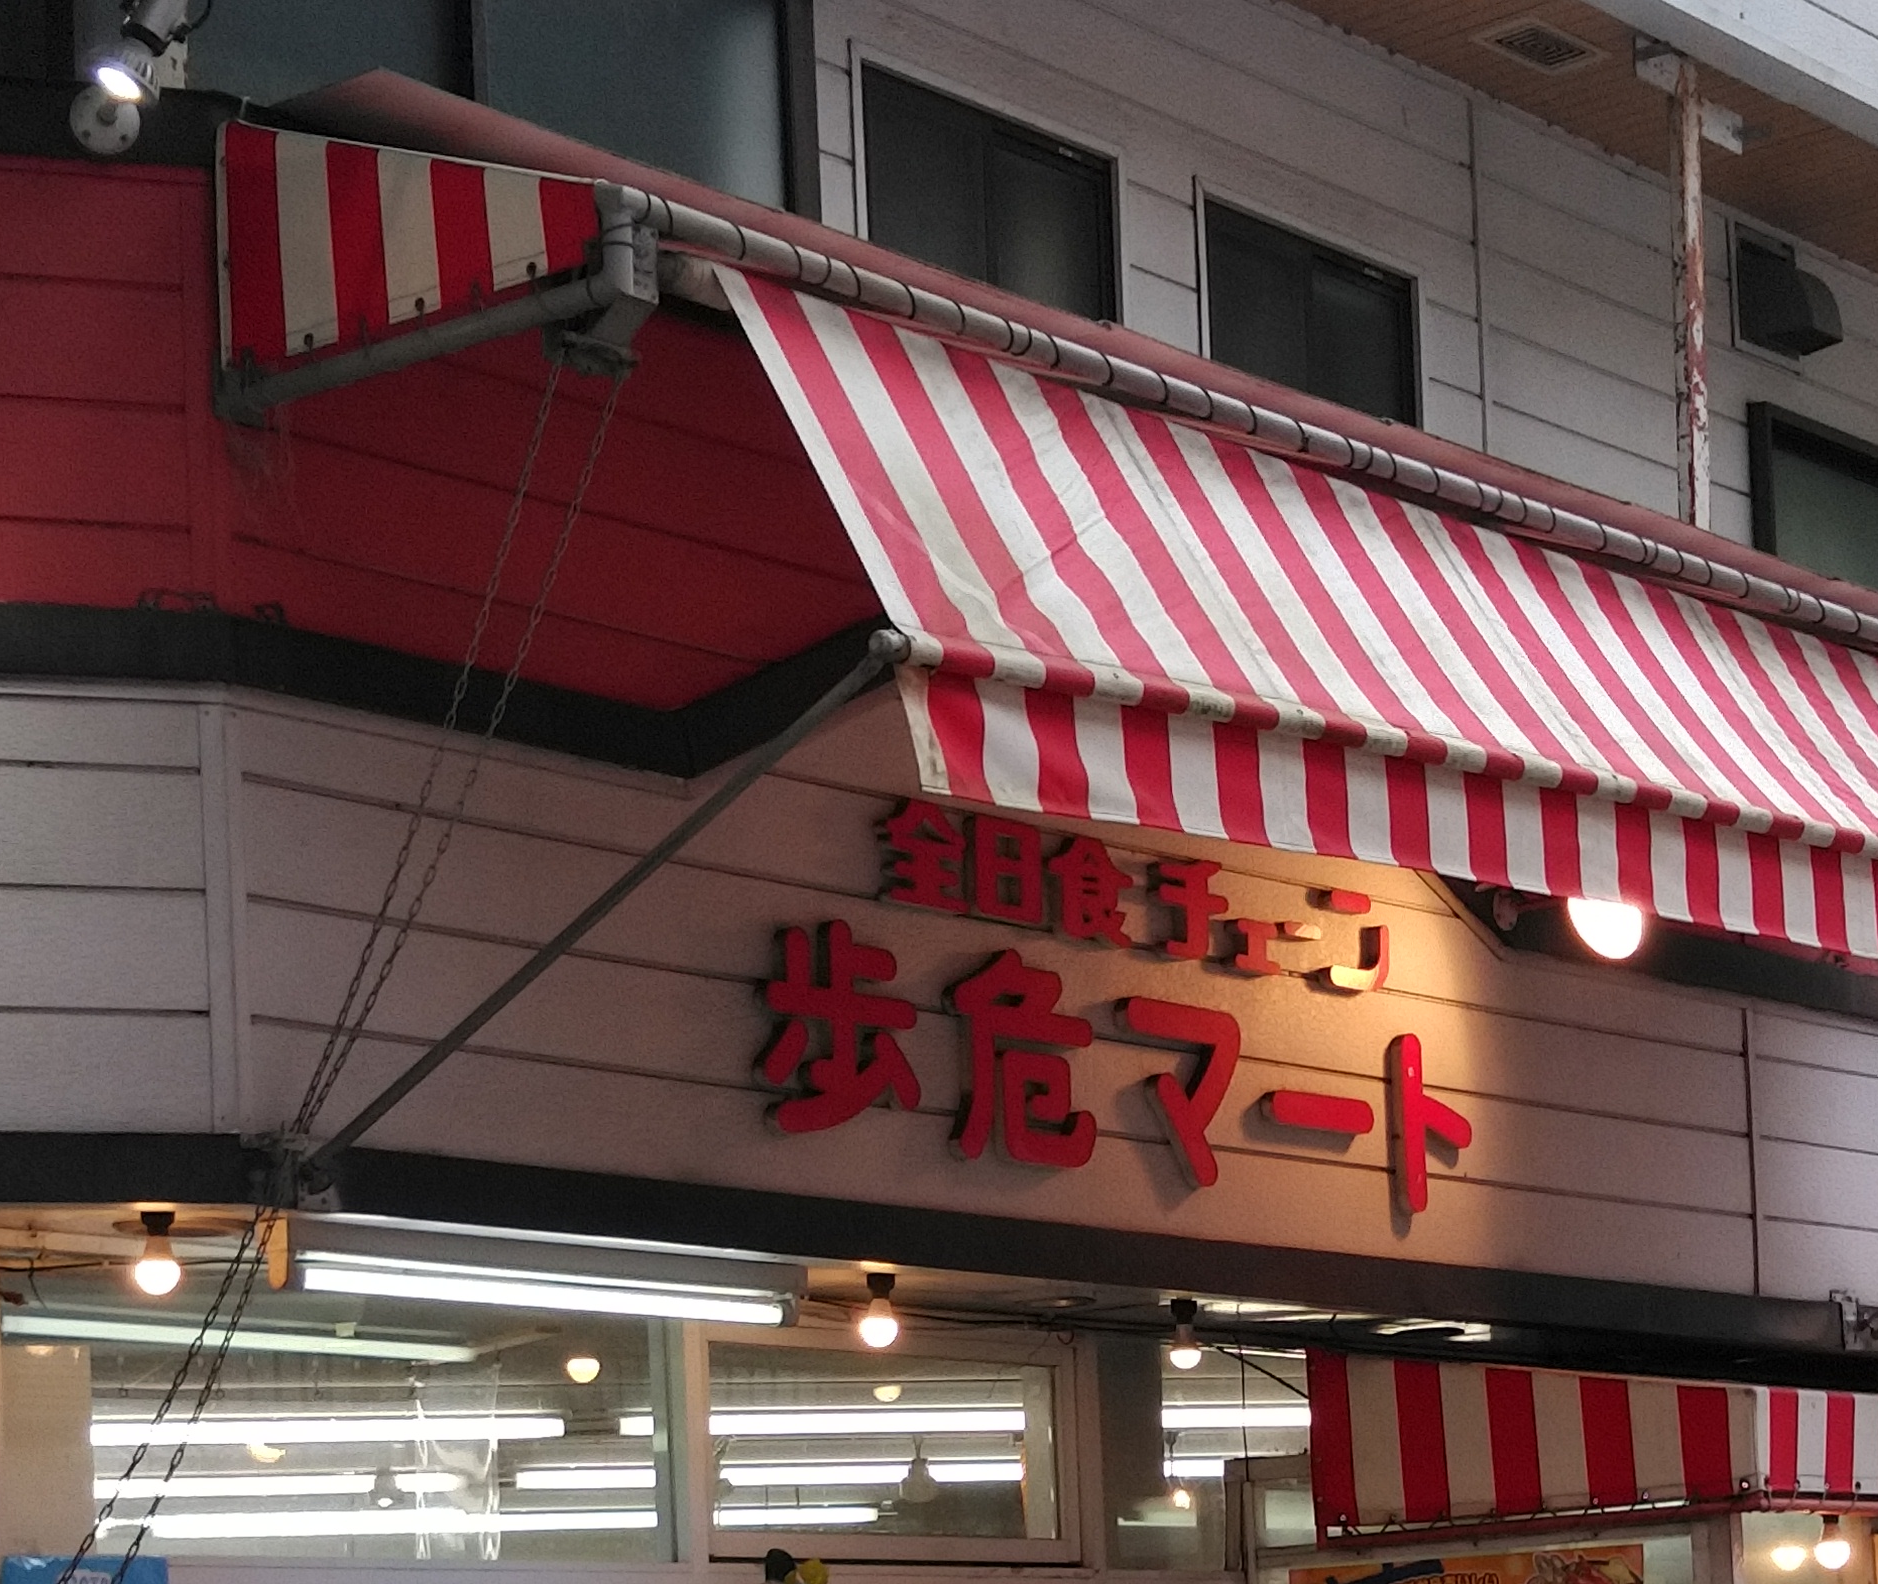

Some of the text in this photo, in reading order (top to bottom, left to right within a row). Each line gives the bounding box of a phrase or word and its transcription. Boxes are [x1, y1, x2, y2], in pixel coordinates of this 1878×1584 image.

[878, 800, 1389, 992] 全日食チェーン
[755, 918, 1473, 1216] 歩危マート
